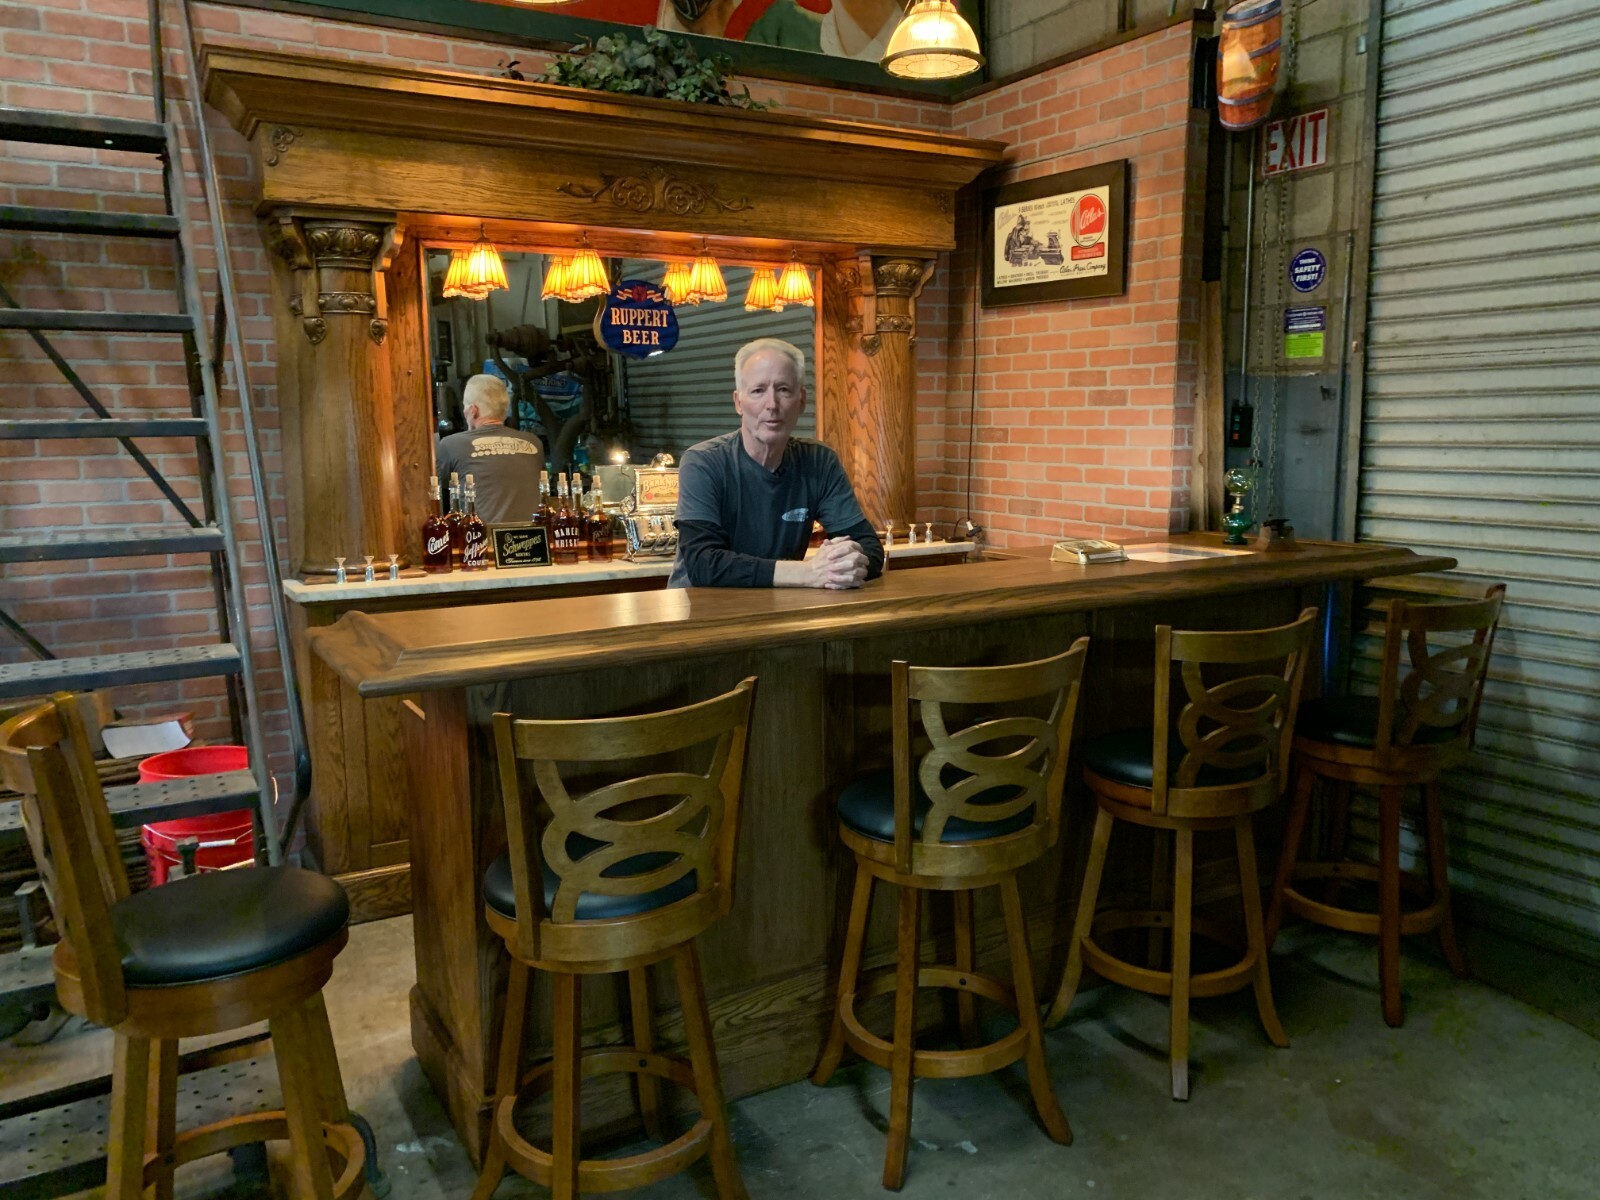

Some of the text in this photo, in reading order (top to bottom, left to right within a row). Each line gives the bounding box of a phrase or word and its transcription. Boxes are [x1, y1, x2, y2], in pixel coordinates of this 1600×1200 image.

[1266, 111, 1326, 173] EXIT
[1080, 207, 1105, 230] Atlas
[1086, 261, 1106, 272] Company
[1294, 264, 1321, 273] SAFETY
[1296, 272, 1318, 282] FIRST!
[610, 307, 669, 328] RUPPERT
[622, 329, 660, 346] BEER
[466, 531, 482, 543] OLD
[502, 534, 542, 557] Schweppes
